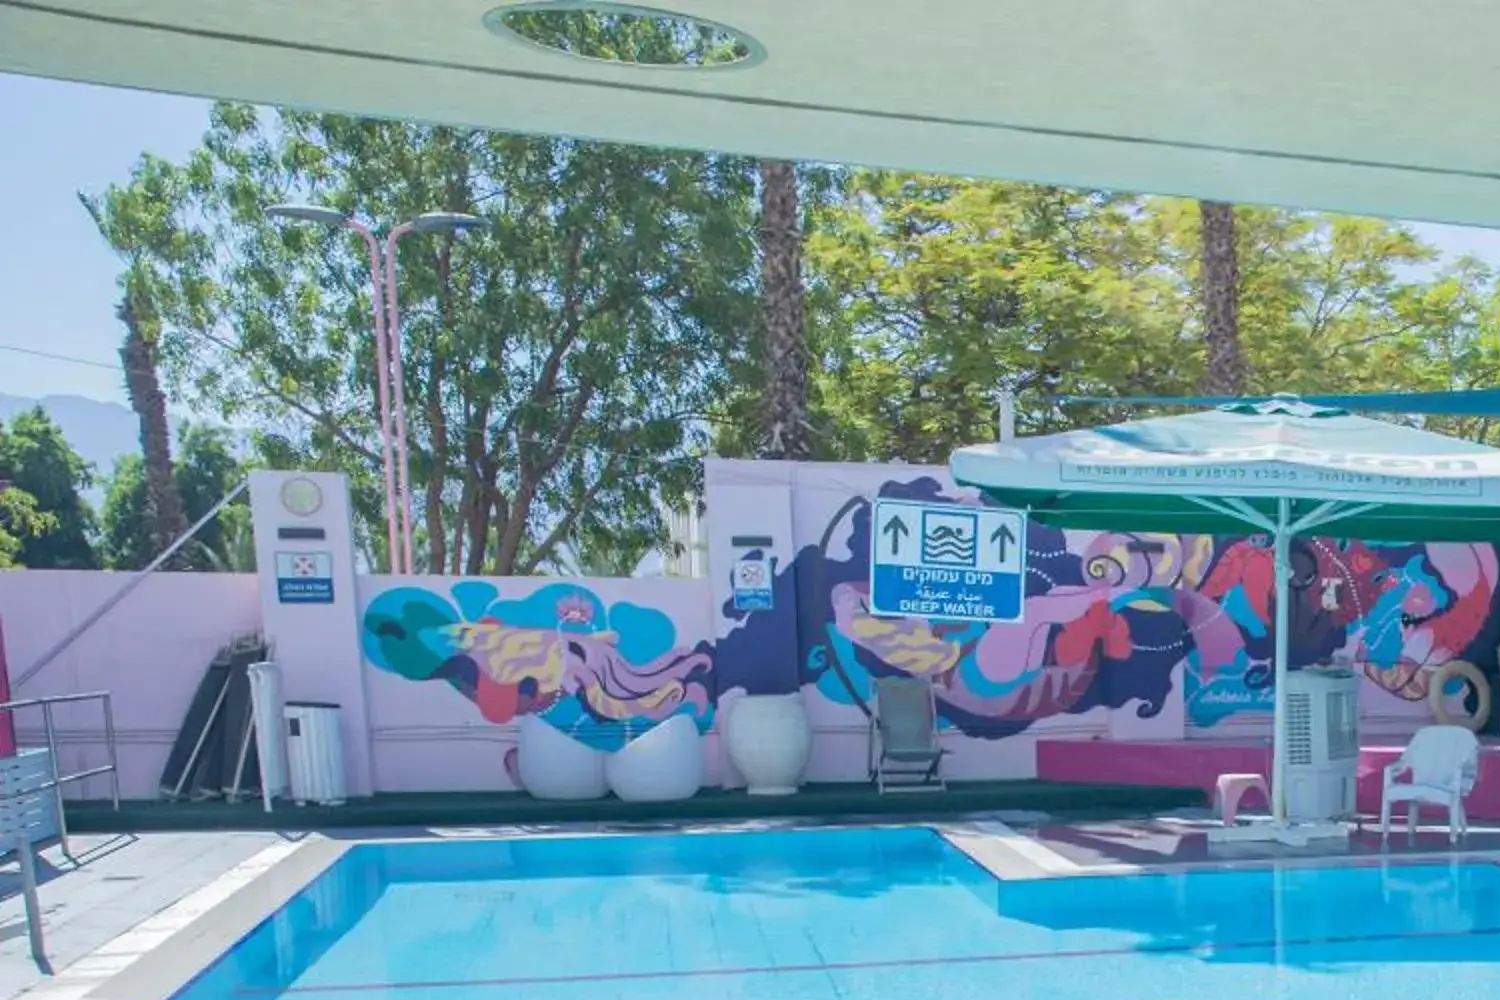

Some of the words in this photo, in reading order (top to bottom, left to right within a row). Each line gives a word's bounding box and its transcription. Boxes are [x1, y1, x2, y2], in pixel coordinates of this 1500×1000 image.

[903, 567, 959, 584] עמוקים
[965, 572, 993, 585] מים
[899, 599, 940, 613] DEEP
[942, 602, 995, 616] WATER
